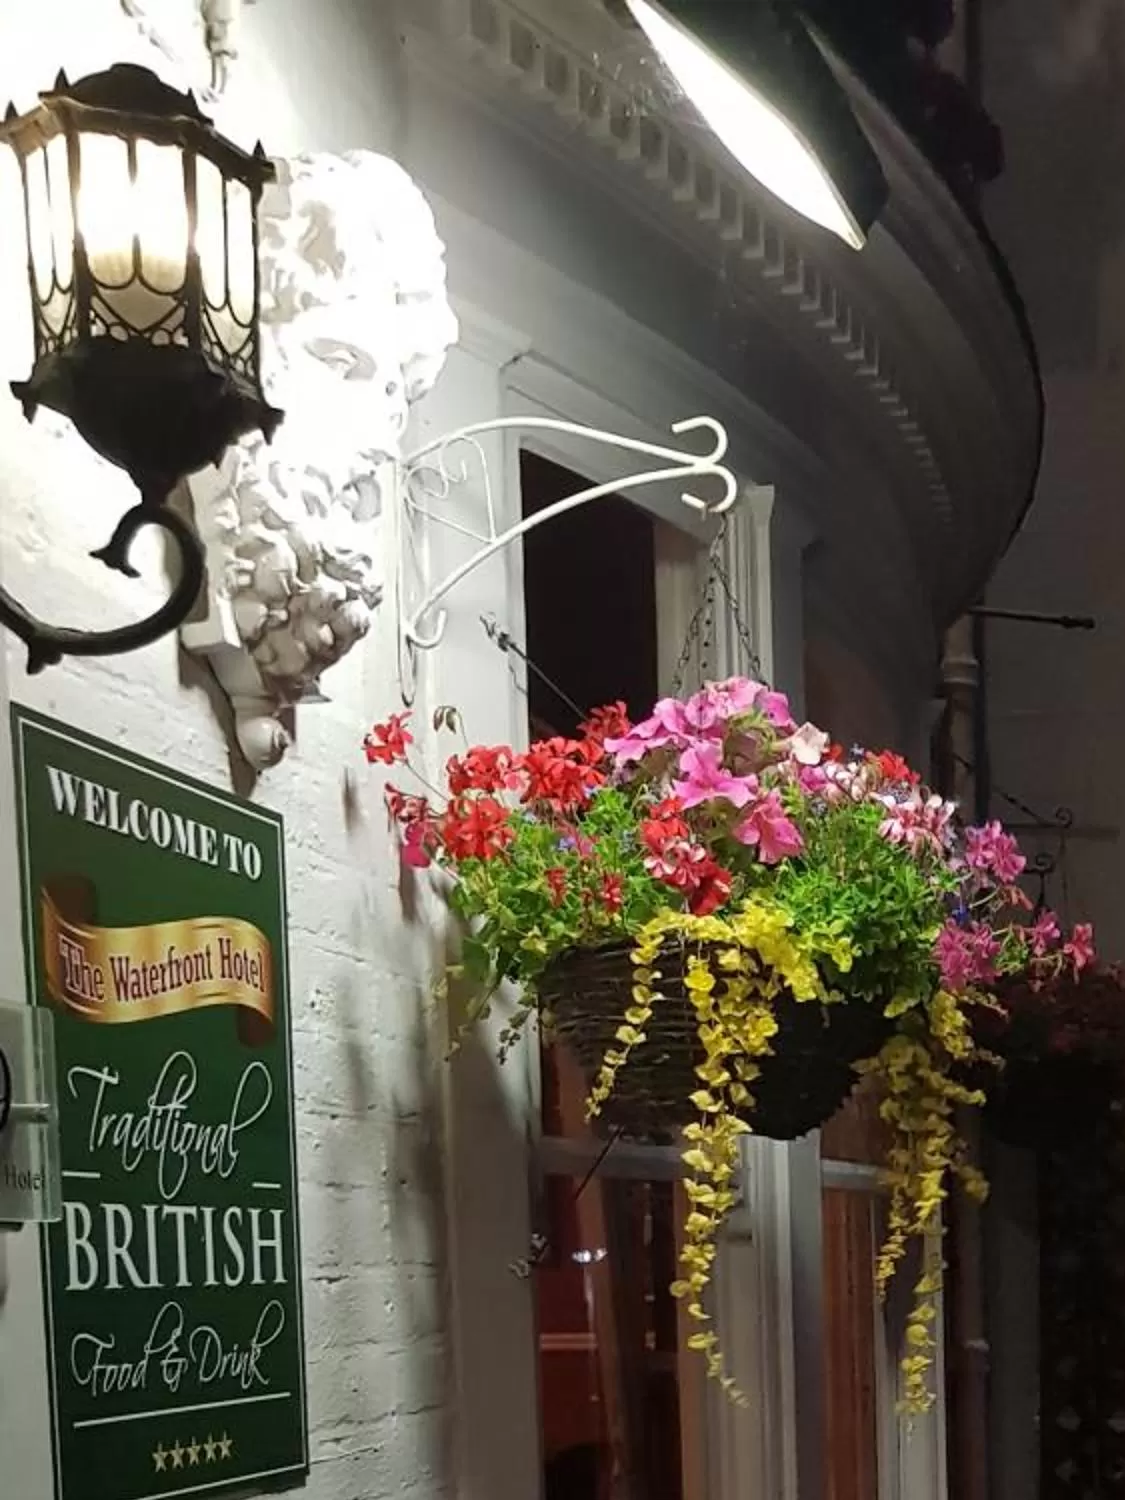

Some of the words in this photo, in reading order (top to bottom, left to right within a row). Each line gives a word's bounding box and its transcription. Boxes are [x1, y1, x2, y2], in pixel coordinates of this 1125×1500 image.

[45, 765, 219, 867] WELCOME
[223, 832, 262, 881] TO
[60, 936, 104, 1000] The
[109, 944, 213, 1002] Waterfront
[218, 937, 265, 992] Hotel
[67, 1051, 273, 1200] Traditional
[63, 1202, 288, 1291] BRITISH
[71, 1301, 184, 1397] Food
[160, 1328, 188, 1391] &
[189, 1300, 285, 1390] Drink
